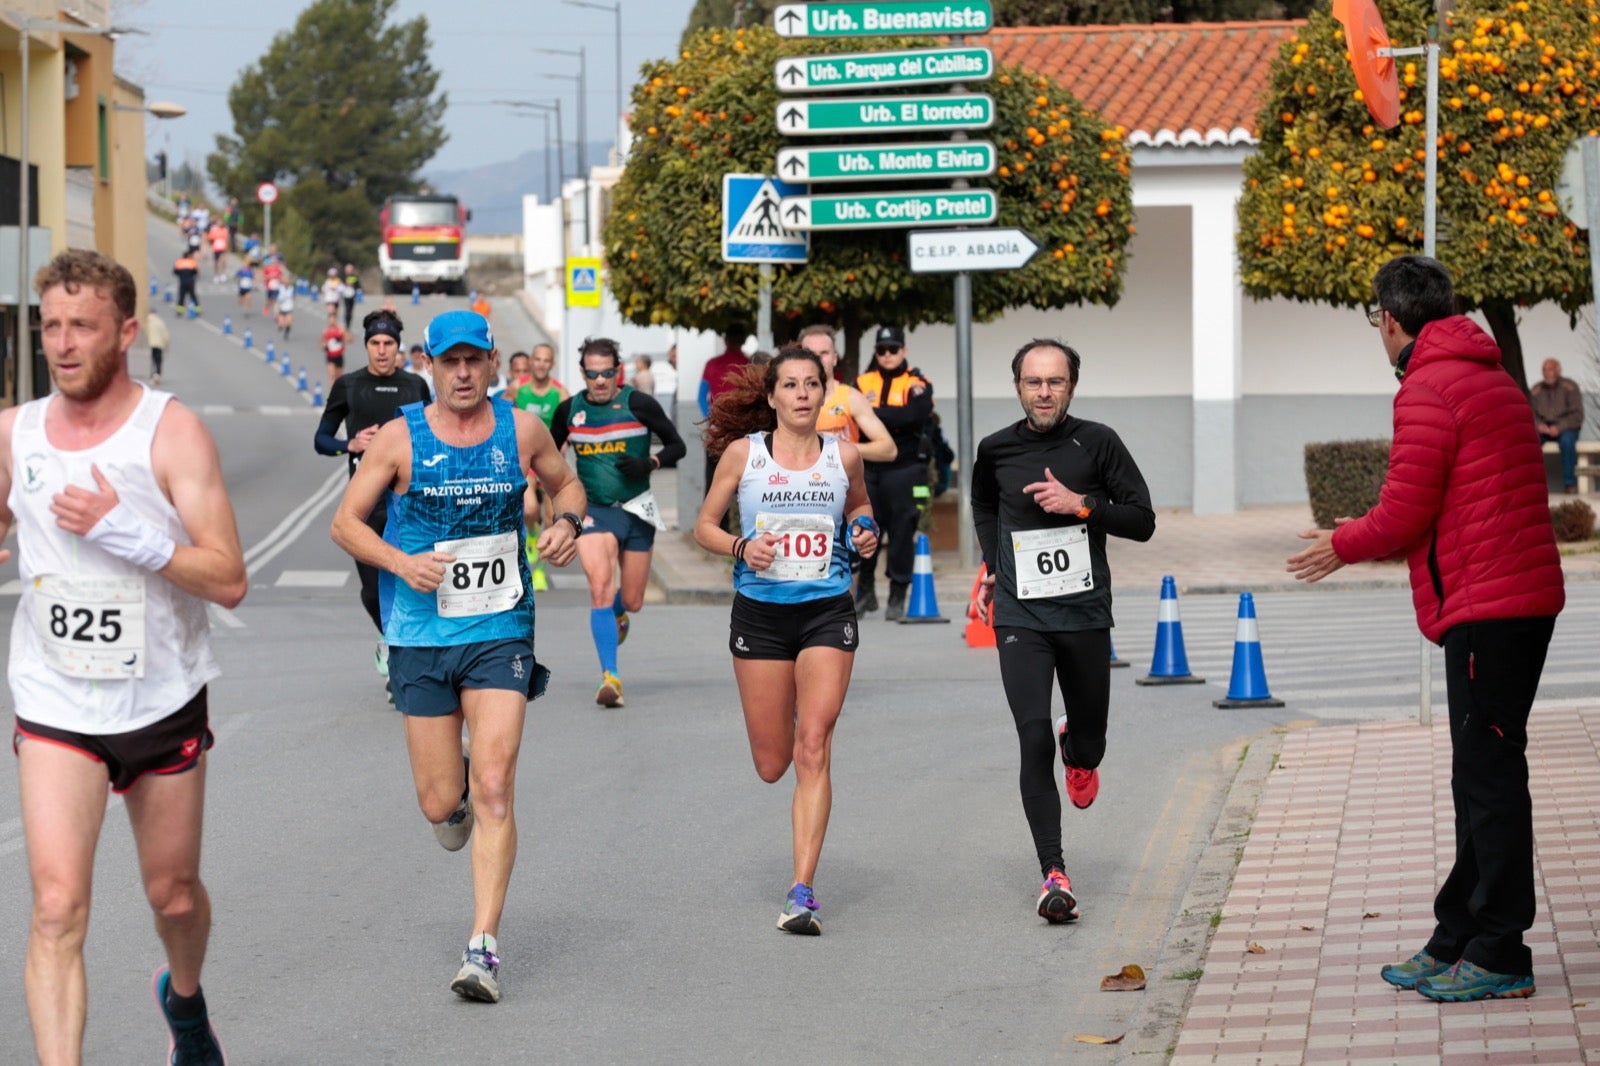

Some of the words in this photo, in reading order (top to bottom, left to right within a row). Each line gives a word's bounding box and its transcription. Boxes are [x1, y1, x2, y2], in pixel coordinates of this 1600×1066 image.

[812, 9, 858, 31] Urb.
[863, 6, 986, 30] Buenavista
[811, 63, 842, 80] Urb.
[845, 60, 896, 82] Parque
[899, 57, 922, 75] del
[925, 55, 983, 74] Cubillas
[860, 104, 896, 122] Urb.
[900, 103, 918, 120] El
[922, 102, 983, 120] torreón
[838, 153, 874, 171] Urb.
[879, 152, 933, 170] Monte
[937, 150, 984, 168] Elvira
[835, 200, 871, 219] Urb.
[875, 199, 932, 220] Cortijo
[936, 197, 986, 215] Pretel
[966, 241, 1021, 256] ABADÍA
[423, 486, 463, 496] PAZITO
[465, 487, 473, 495] a
[474, 483, 513, 494] PAZITO
[761, 491, 835, 503] MARACENA
[457, 497, 482, 506] Motril
[1037, 549, 1070, 575] 60
[452, 557, 506, 591] 870
[50, 603, 122, 643] 825
